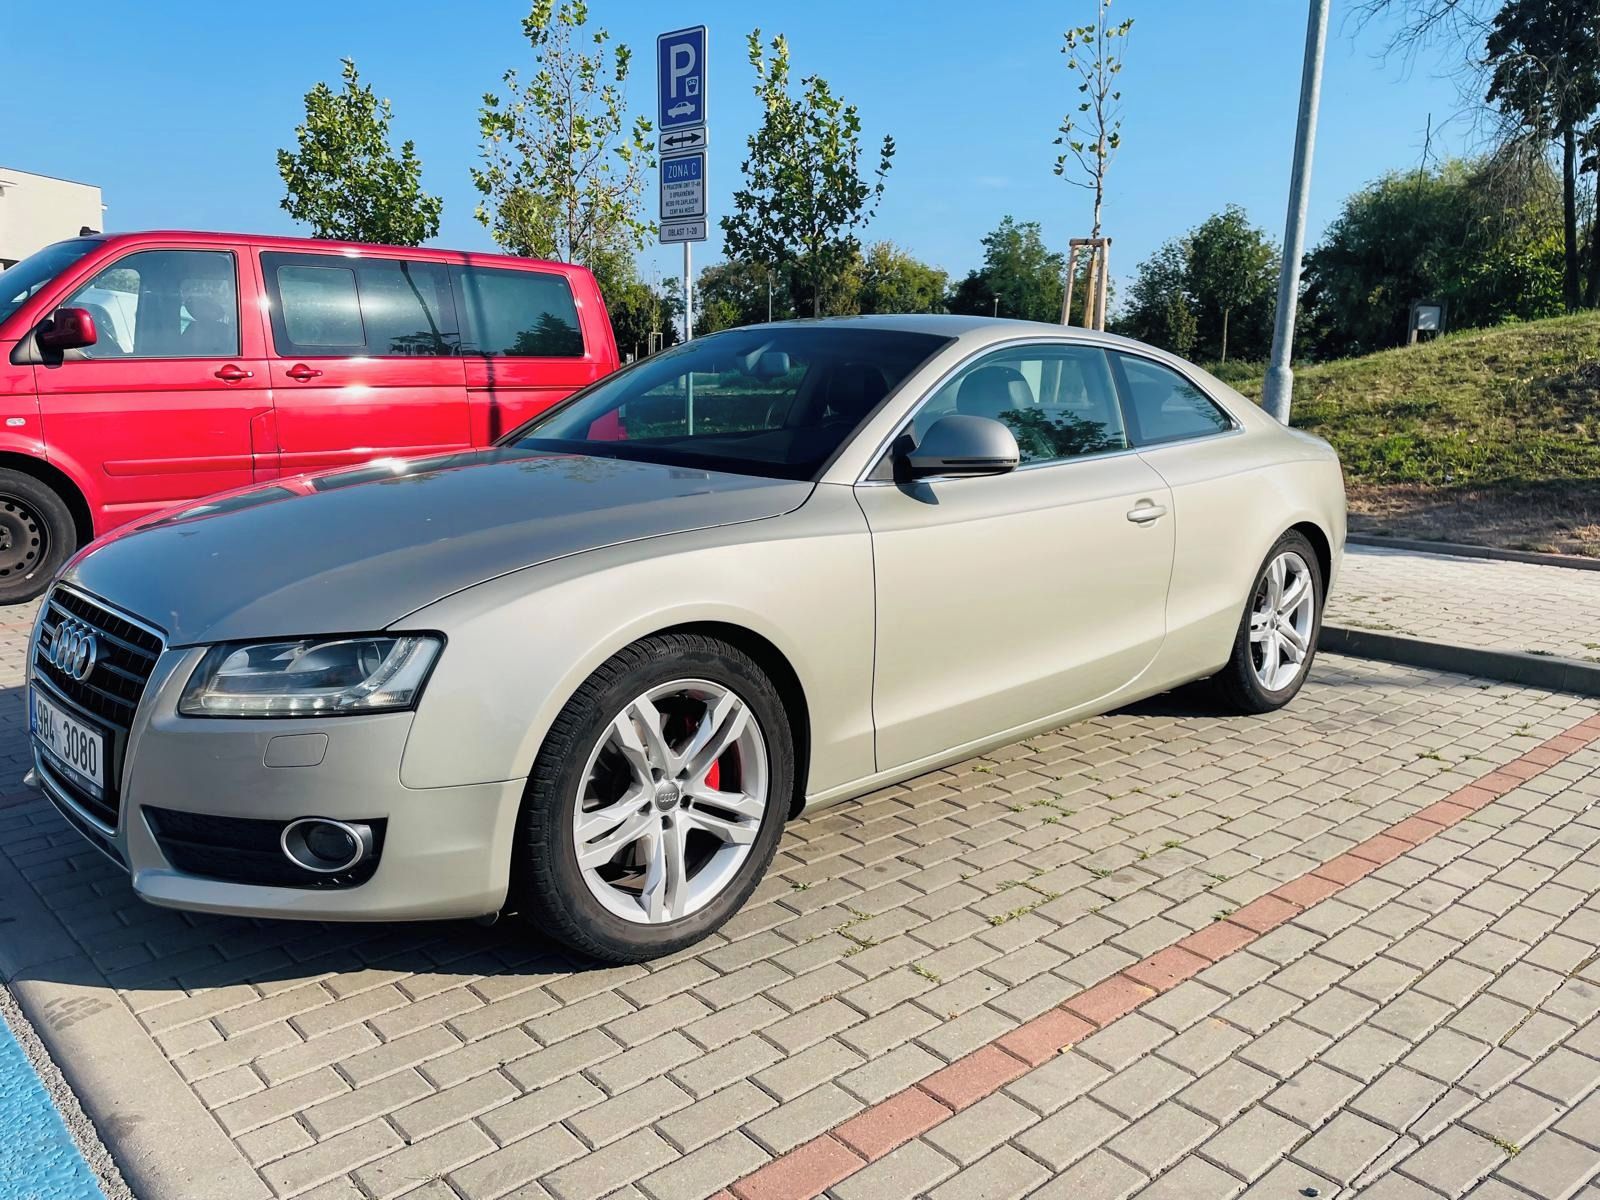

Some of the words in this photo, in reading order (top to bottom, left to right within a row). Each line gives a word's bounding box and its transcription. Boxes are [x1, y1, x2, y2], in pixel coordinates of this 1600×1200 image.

[670, 43, 696, 98] P
[668, 162, 688, 178] ZÓNA
[691, 162, 697, 176] C
[668, 228, 684, 236] OBLAST
[37, 699, 55, 746] 9B4
[63, 720, 97, 777] 3080
